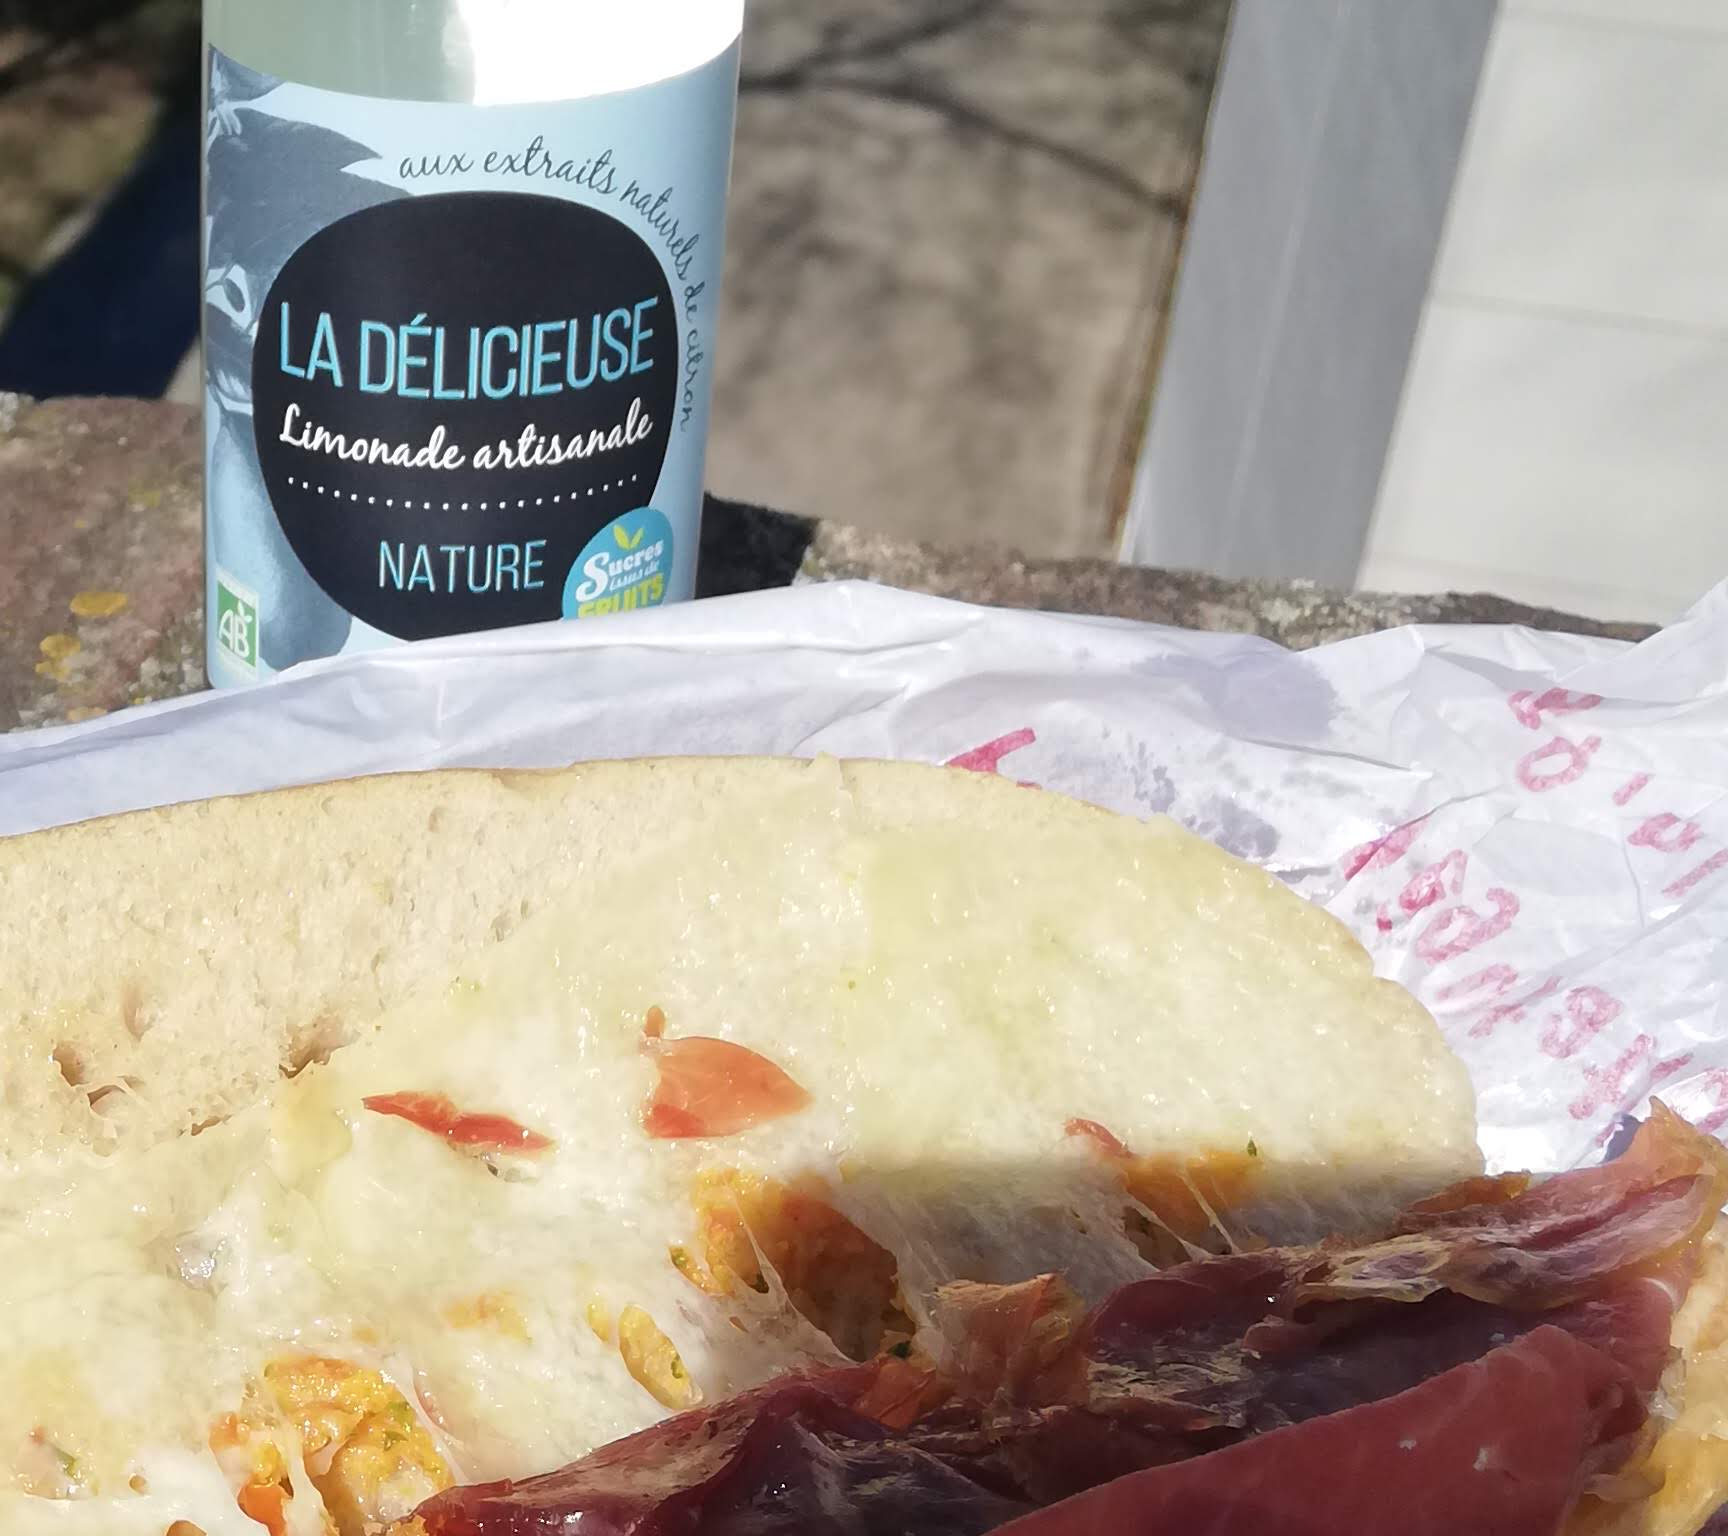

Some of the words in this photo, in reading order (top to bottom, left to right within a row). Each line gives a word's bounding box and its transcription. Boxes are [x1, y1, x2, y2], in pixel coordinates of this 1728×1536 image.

[399, 148, 475, 179] aux
[481, 135, 618, 196] extraits
[620, 179, 700, 280] naturels
[684, 281, 705, 323] de
[280, 301, 344, 388] LA
[359, 296, 661, 400] DÉLICIEUSE
[680, 328, 704, 432] citron
[279, 403, 466, 470] Limonade
[473, 397, 654, 470] artisanale
[379, 539, 547, 593] NATURE
[575, 538, 665, 602] Sucres
[578, 572, 664, 618] FRUITS
[218, 607, 251, 659] AB
